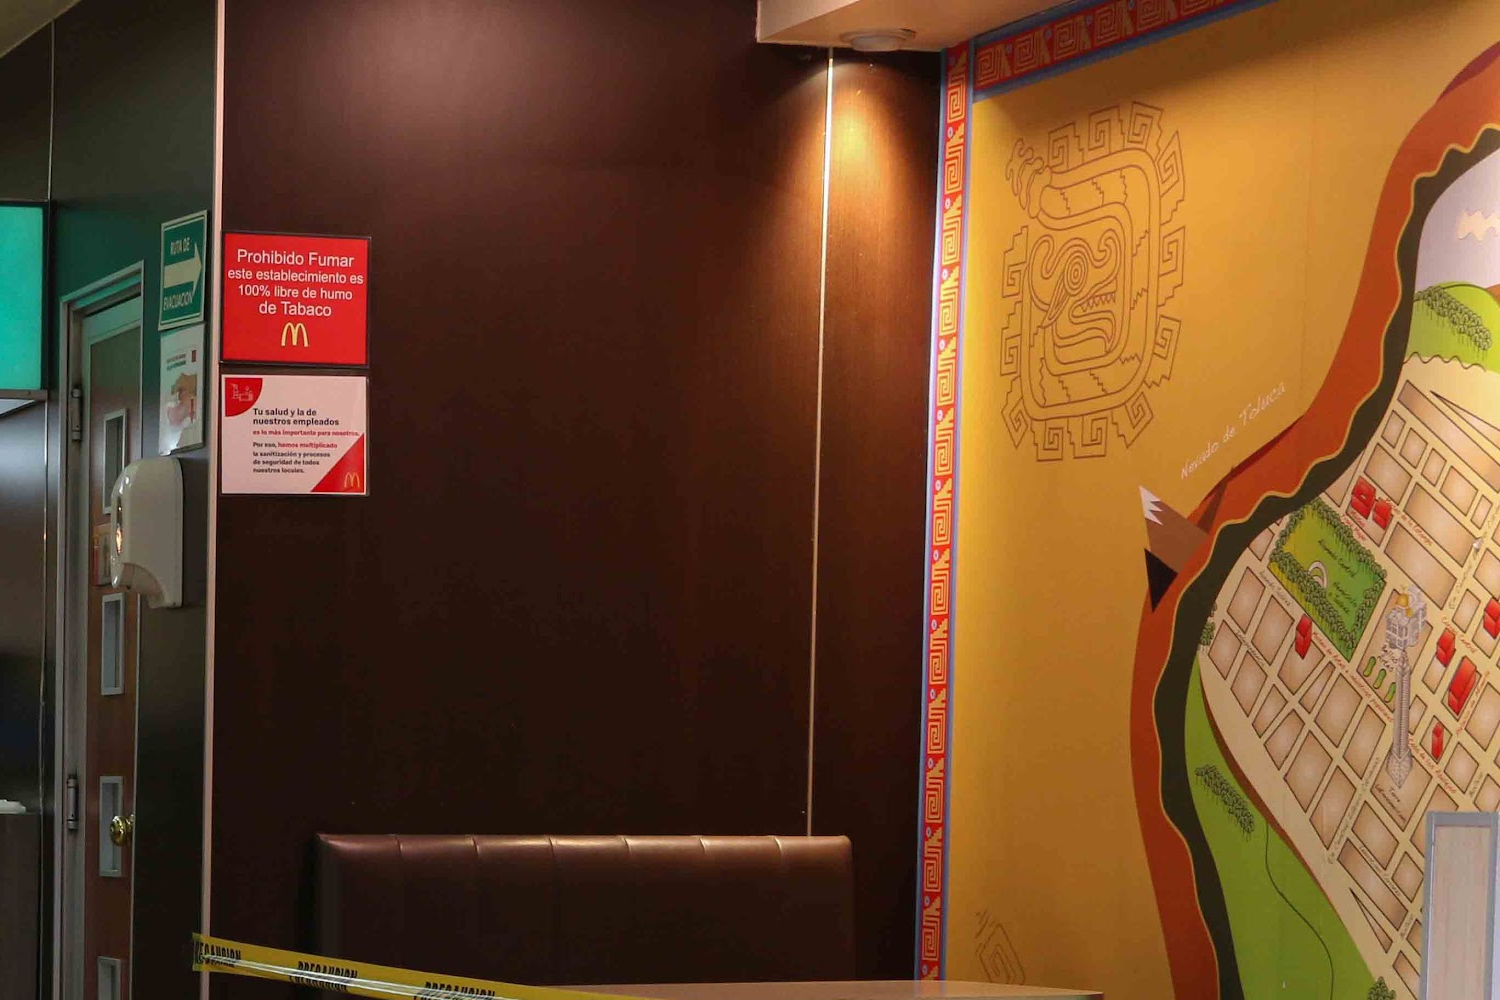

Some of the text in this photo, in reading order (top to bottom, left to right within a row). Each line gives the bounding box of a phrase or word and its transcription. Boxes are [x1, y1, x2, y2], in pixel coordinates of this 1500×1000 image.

[182, 237, 191, 252] DE
[237, 249, 355, 267] Prohibido Fumar
[227, 269, 364, 284] este establecimiento es
[238, 284, 353, 300] 100% libre de humo
[259, 301, 332, 317] de Tabaco
[253, 408, 317, 418] Tu salud y la de
[253, 418, 340, 427] nuestros empleados
[282, 429, 317, 437] importante
[1180, 381, 1286, 480] Nevado de Toluca
[261, 459, 293, 467] seguridad
